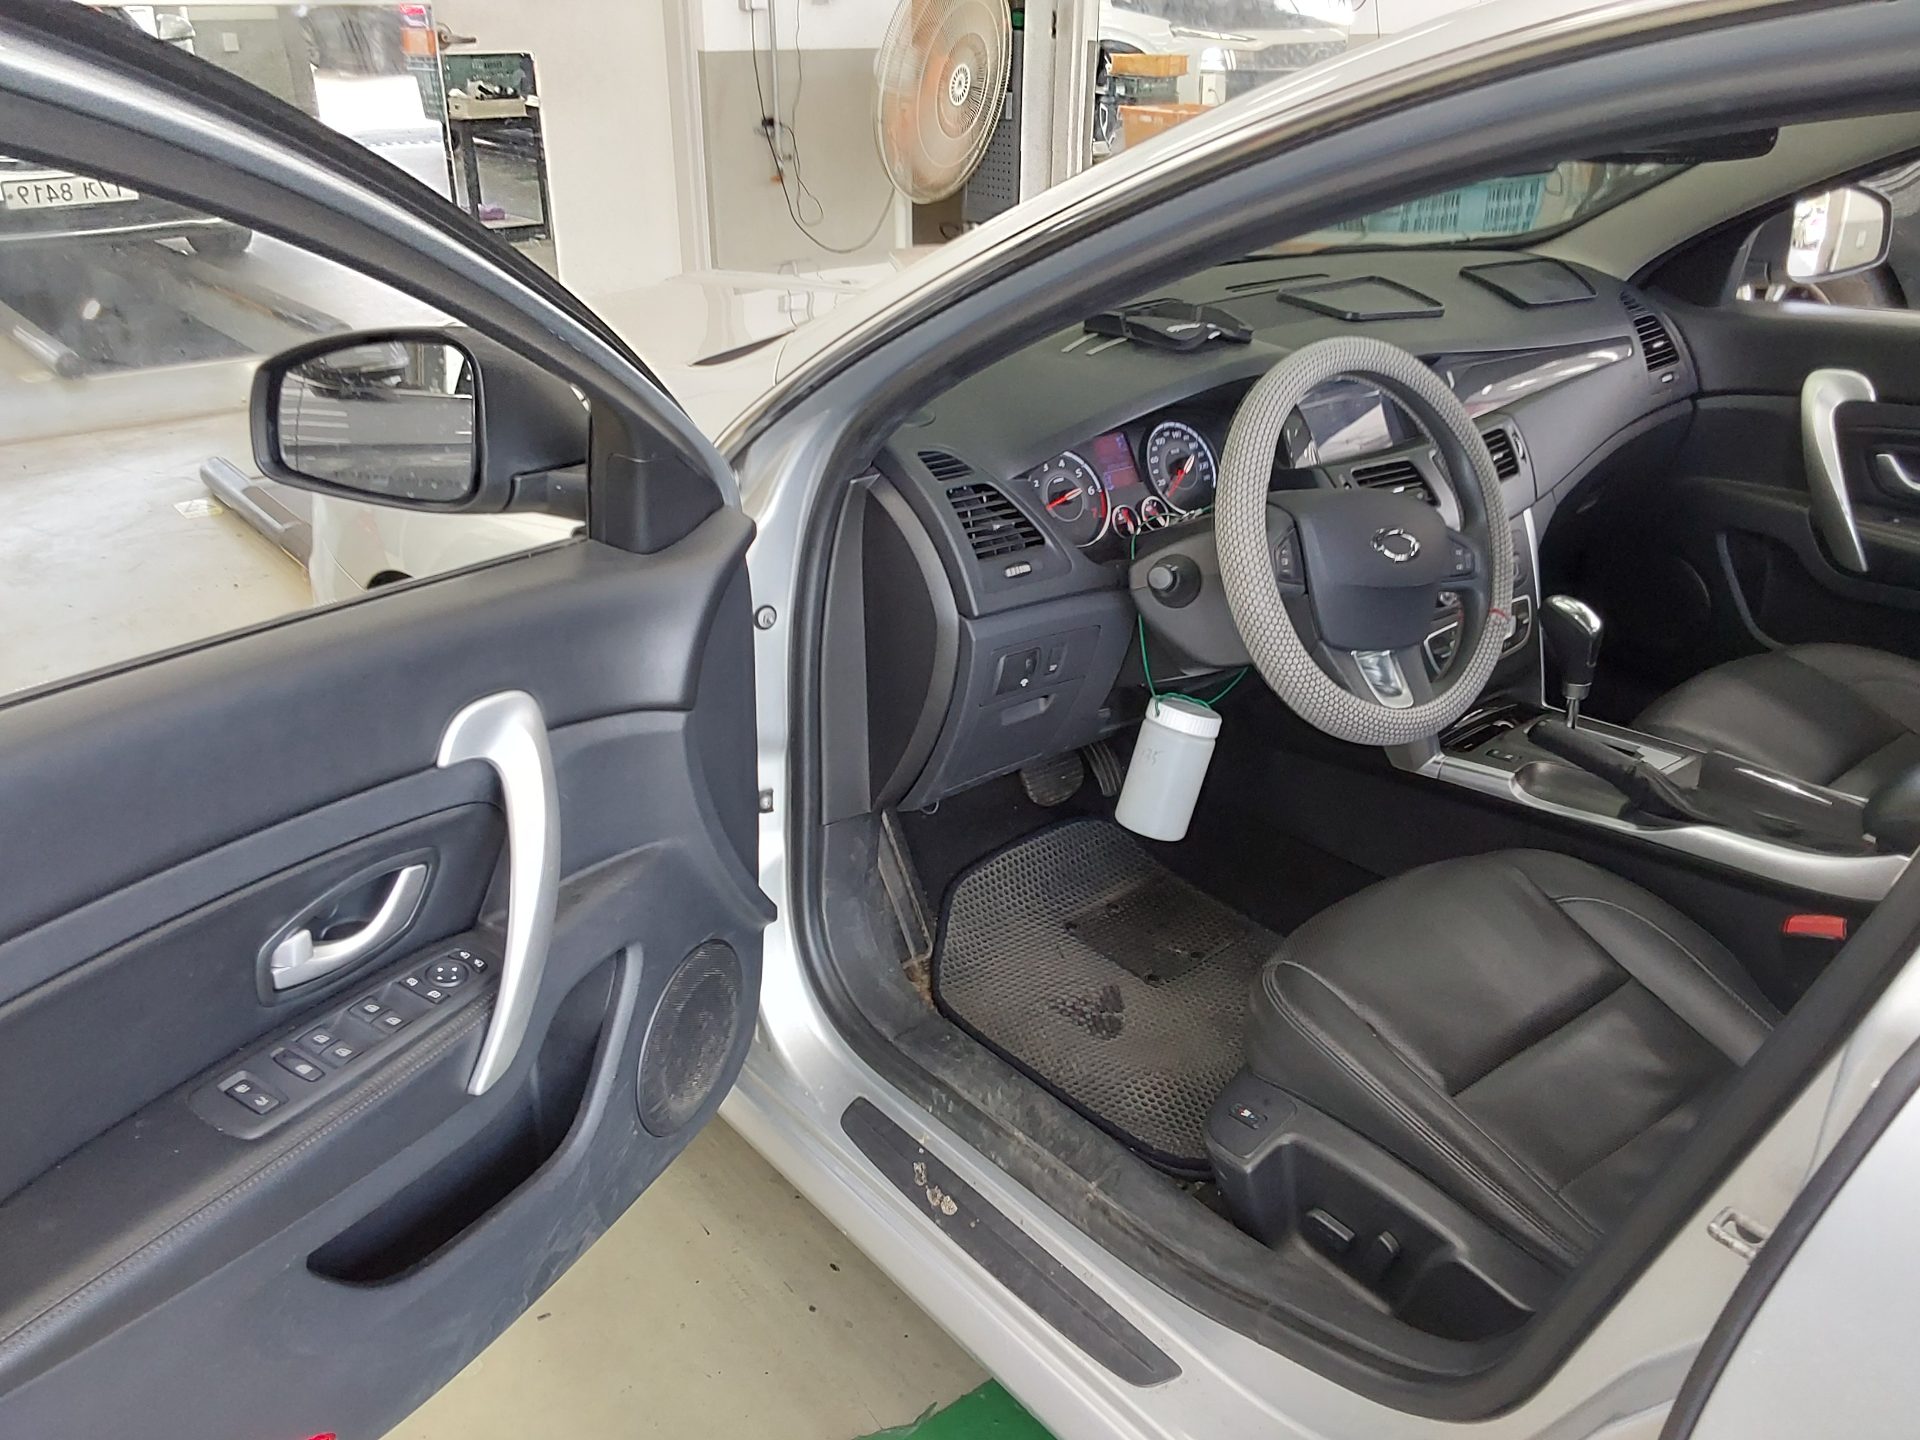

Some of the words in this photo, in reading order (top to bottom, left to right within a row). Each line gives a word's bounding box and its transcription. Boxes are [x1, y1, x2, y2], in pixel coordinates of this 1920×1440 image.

[1058, 459, 1065, 468] 4
[1075, 468, 1083, 478] 5
[1034, 480, 1040, 488] 2
[1087, 486, 1095, 495] 6
